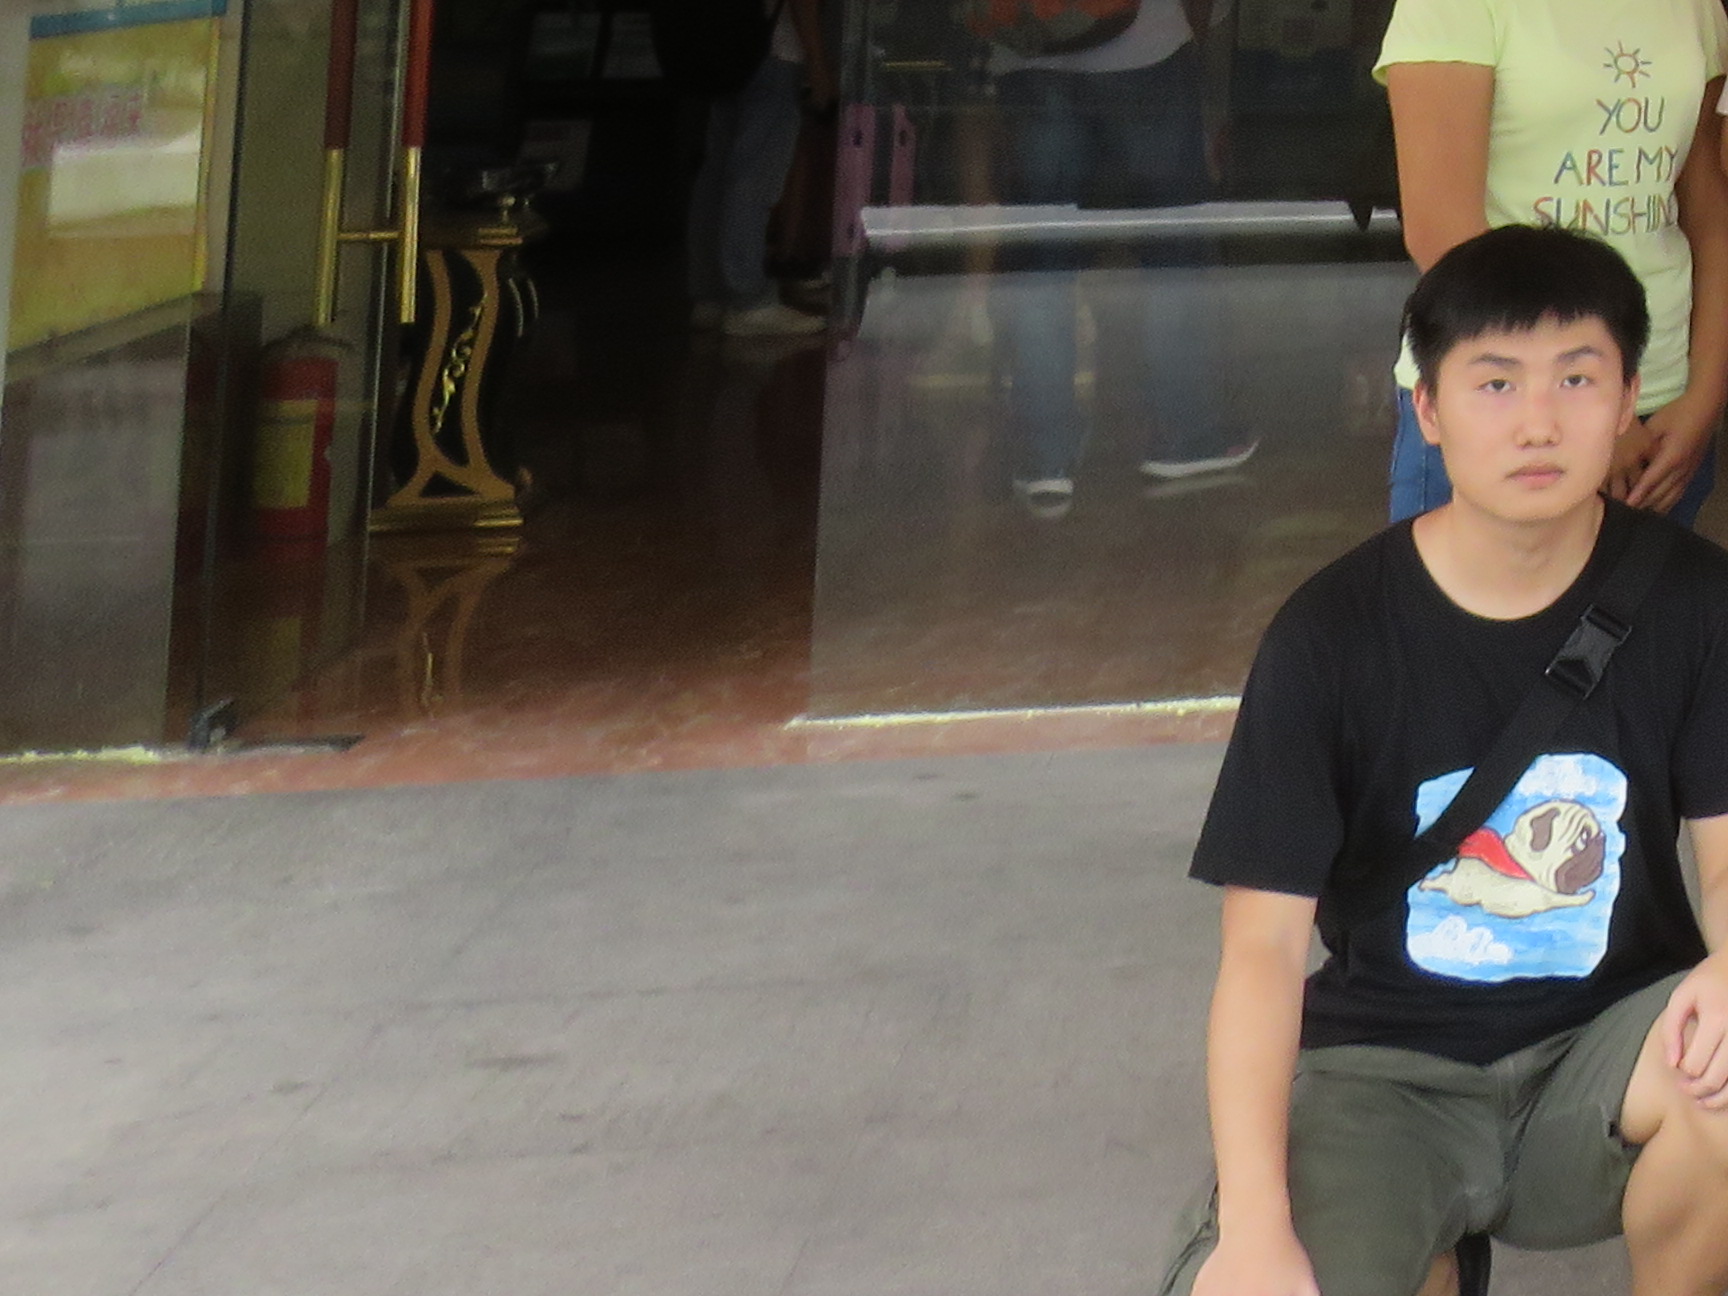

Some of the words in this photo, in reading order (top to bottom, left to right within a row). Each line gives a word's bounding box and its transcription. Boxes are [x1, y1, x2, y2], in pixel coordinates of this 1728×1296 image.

[1596, 96, 1665, 135] YOU
[1554, 147, 1628, 186] ARE
[1636, 146, 1678, 184] MY
